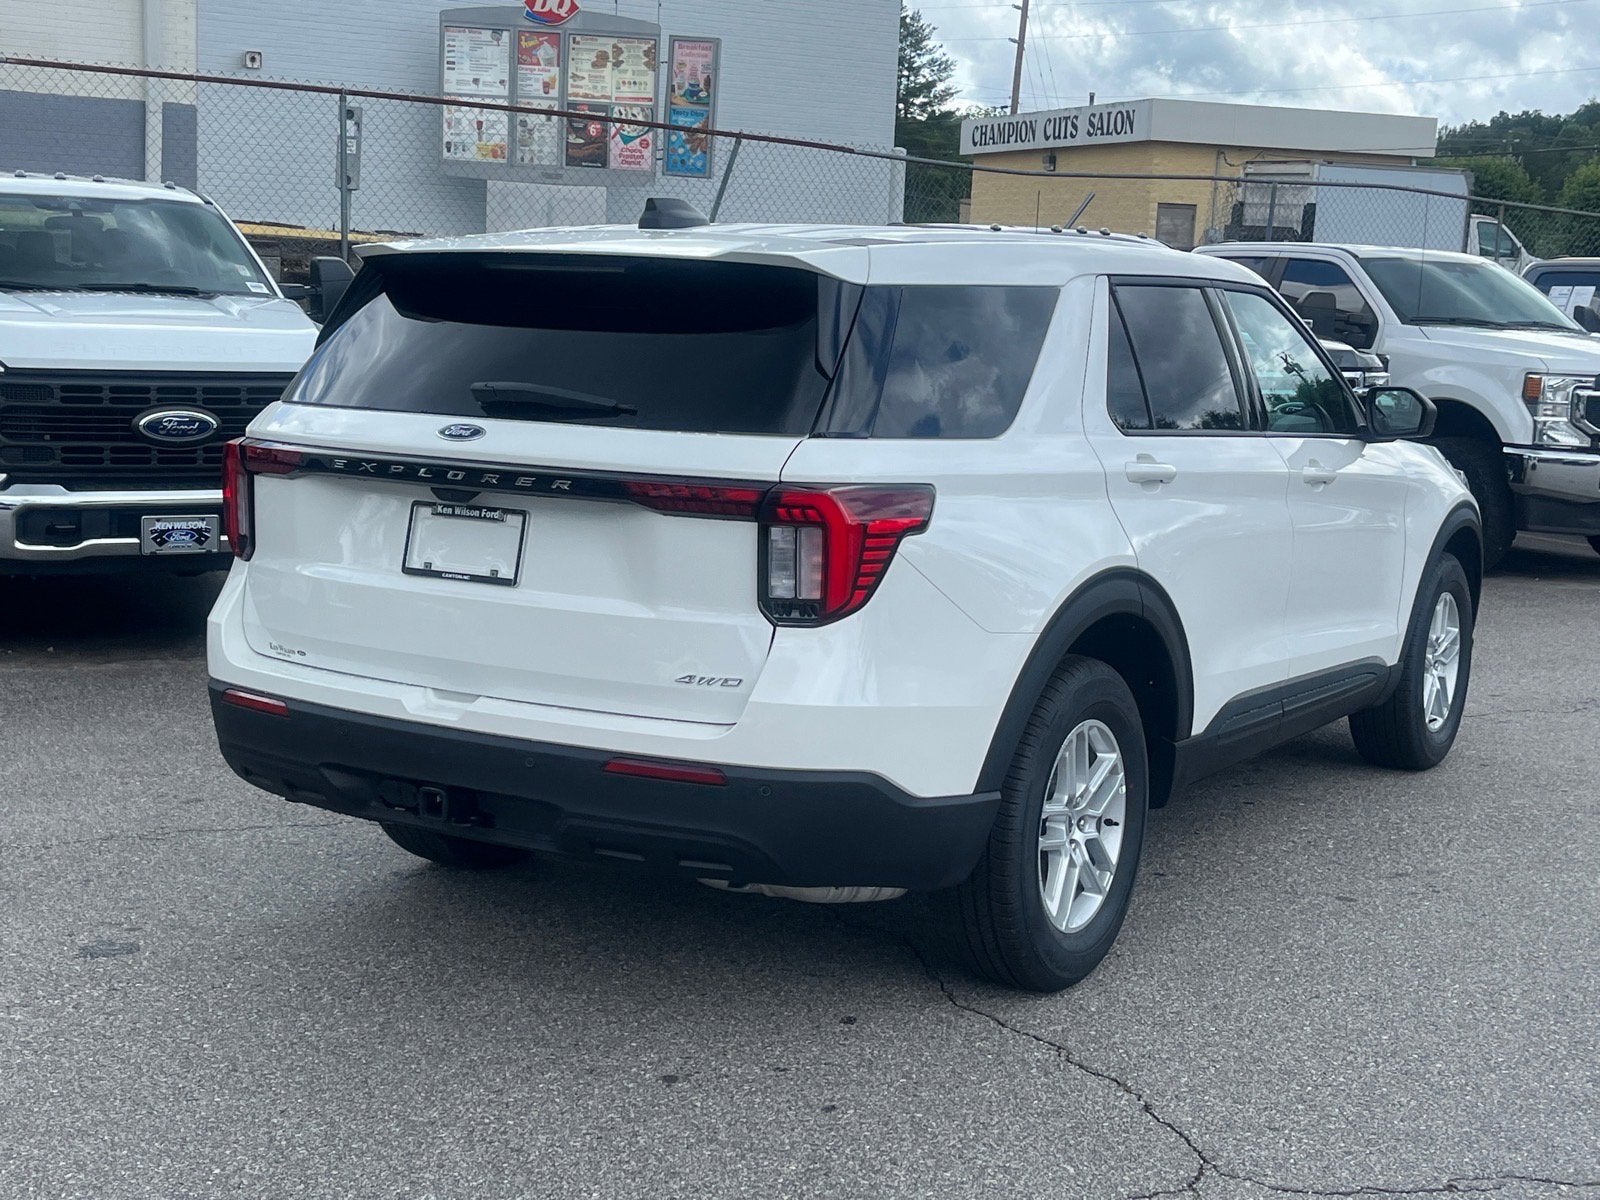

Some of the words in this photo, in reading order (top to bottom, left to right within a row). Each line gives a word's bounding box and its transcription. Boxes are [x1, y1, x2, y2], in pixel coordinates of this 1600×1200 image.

[972, 119, 1038, 147] CHAMPION
[1043, 114, 1079, 142] CUTS
[1086, 109, 1136, 137] SALON
[160, 417, 200, 432] Ford
[444, 424, 475, 437] Ford
[333, 459, 572, 490] EXPLORER
[437, 505, 452, 514] Ken
[454, 507, 479, 517] Wilson
[481, 509, 499, 519] Ford
[170, 531, 192, 541] Ford
[674, 675, 743, 687] 4WD
